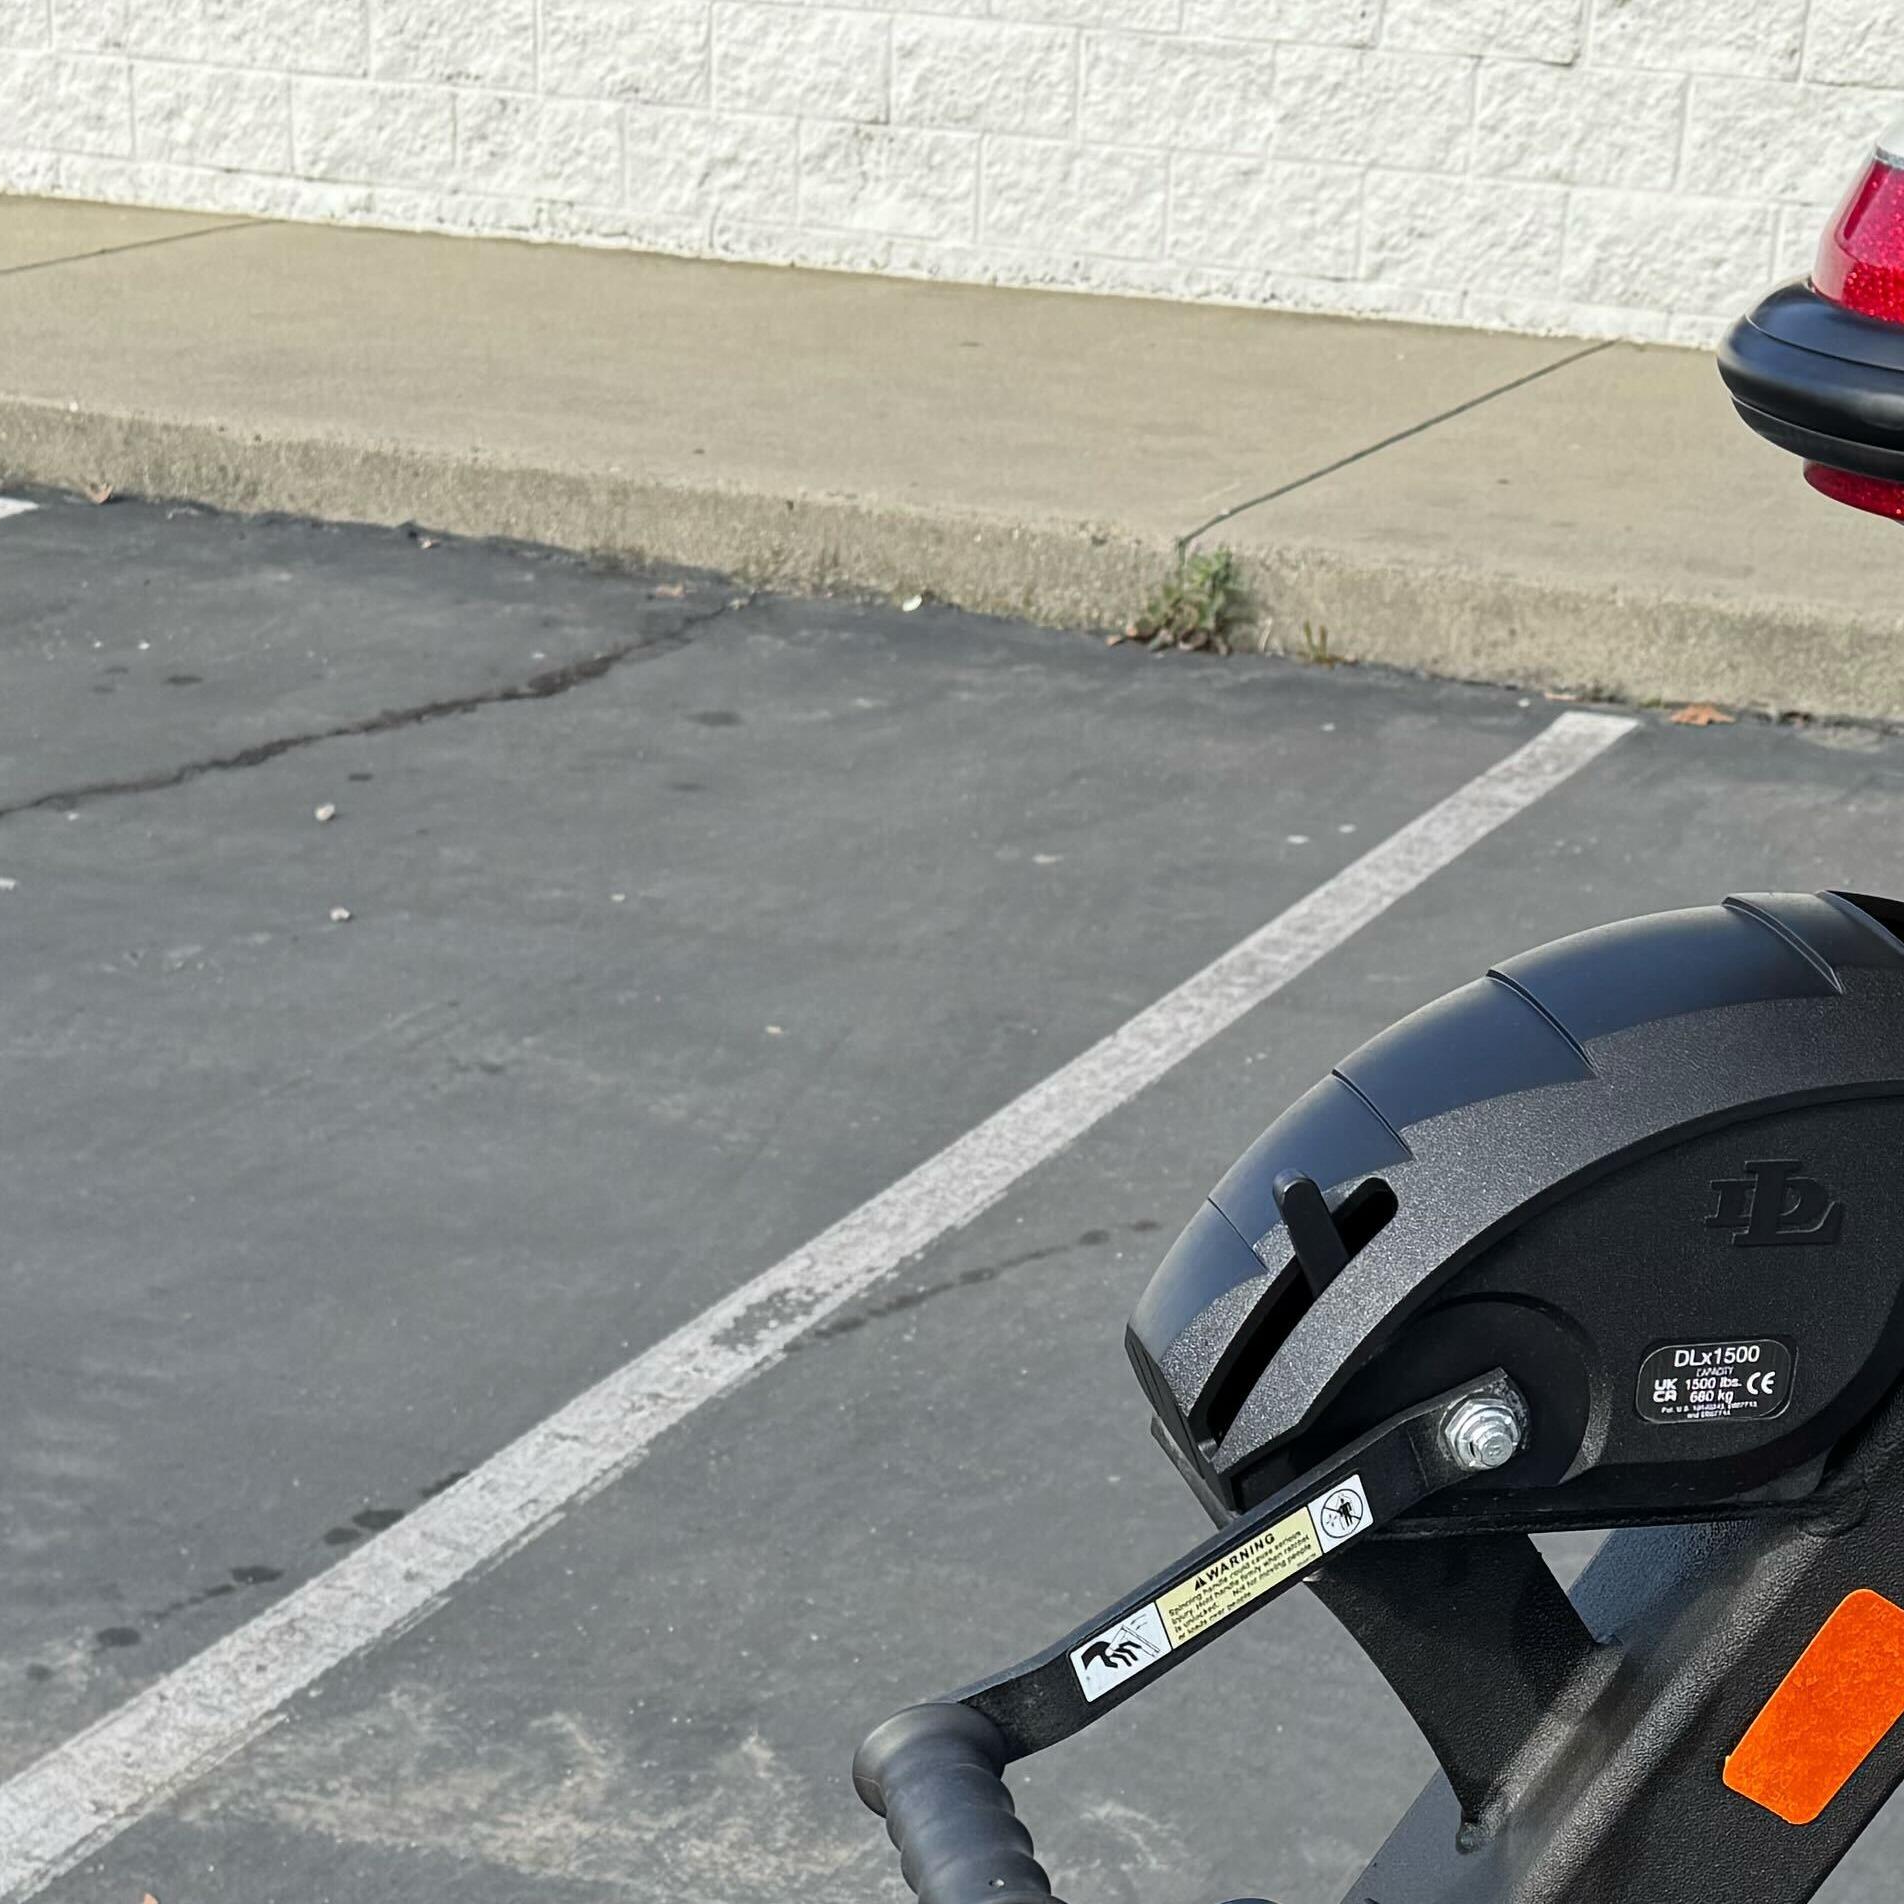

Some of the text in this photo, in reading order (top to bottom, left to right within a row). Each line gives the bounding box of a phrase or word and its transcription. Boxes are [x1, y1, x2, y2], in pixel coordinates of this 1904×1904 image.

[1674, 1345, 1760, 1367] DLx1500
[1654, 1378, 1678, 1391] UK
[1685, 1378, 1716, 1391] 1500
[1746, 1371, 1776, 1395] CE
[1653, 1390, 1677, 1403] CA
[1690, 1390, 1734, 1404] 680 kg
[1206, 1533, 1275, 1581] WARNING
